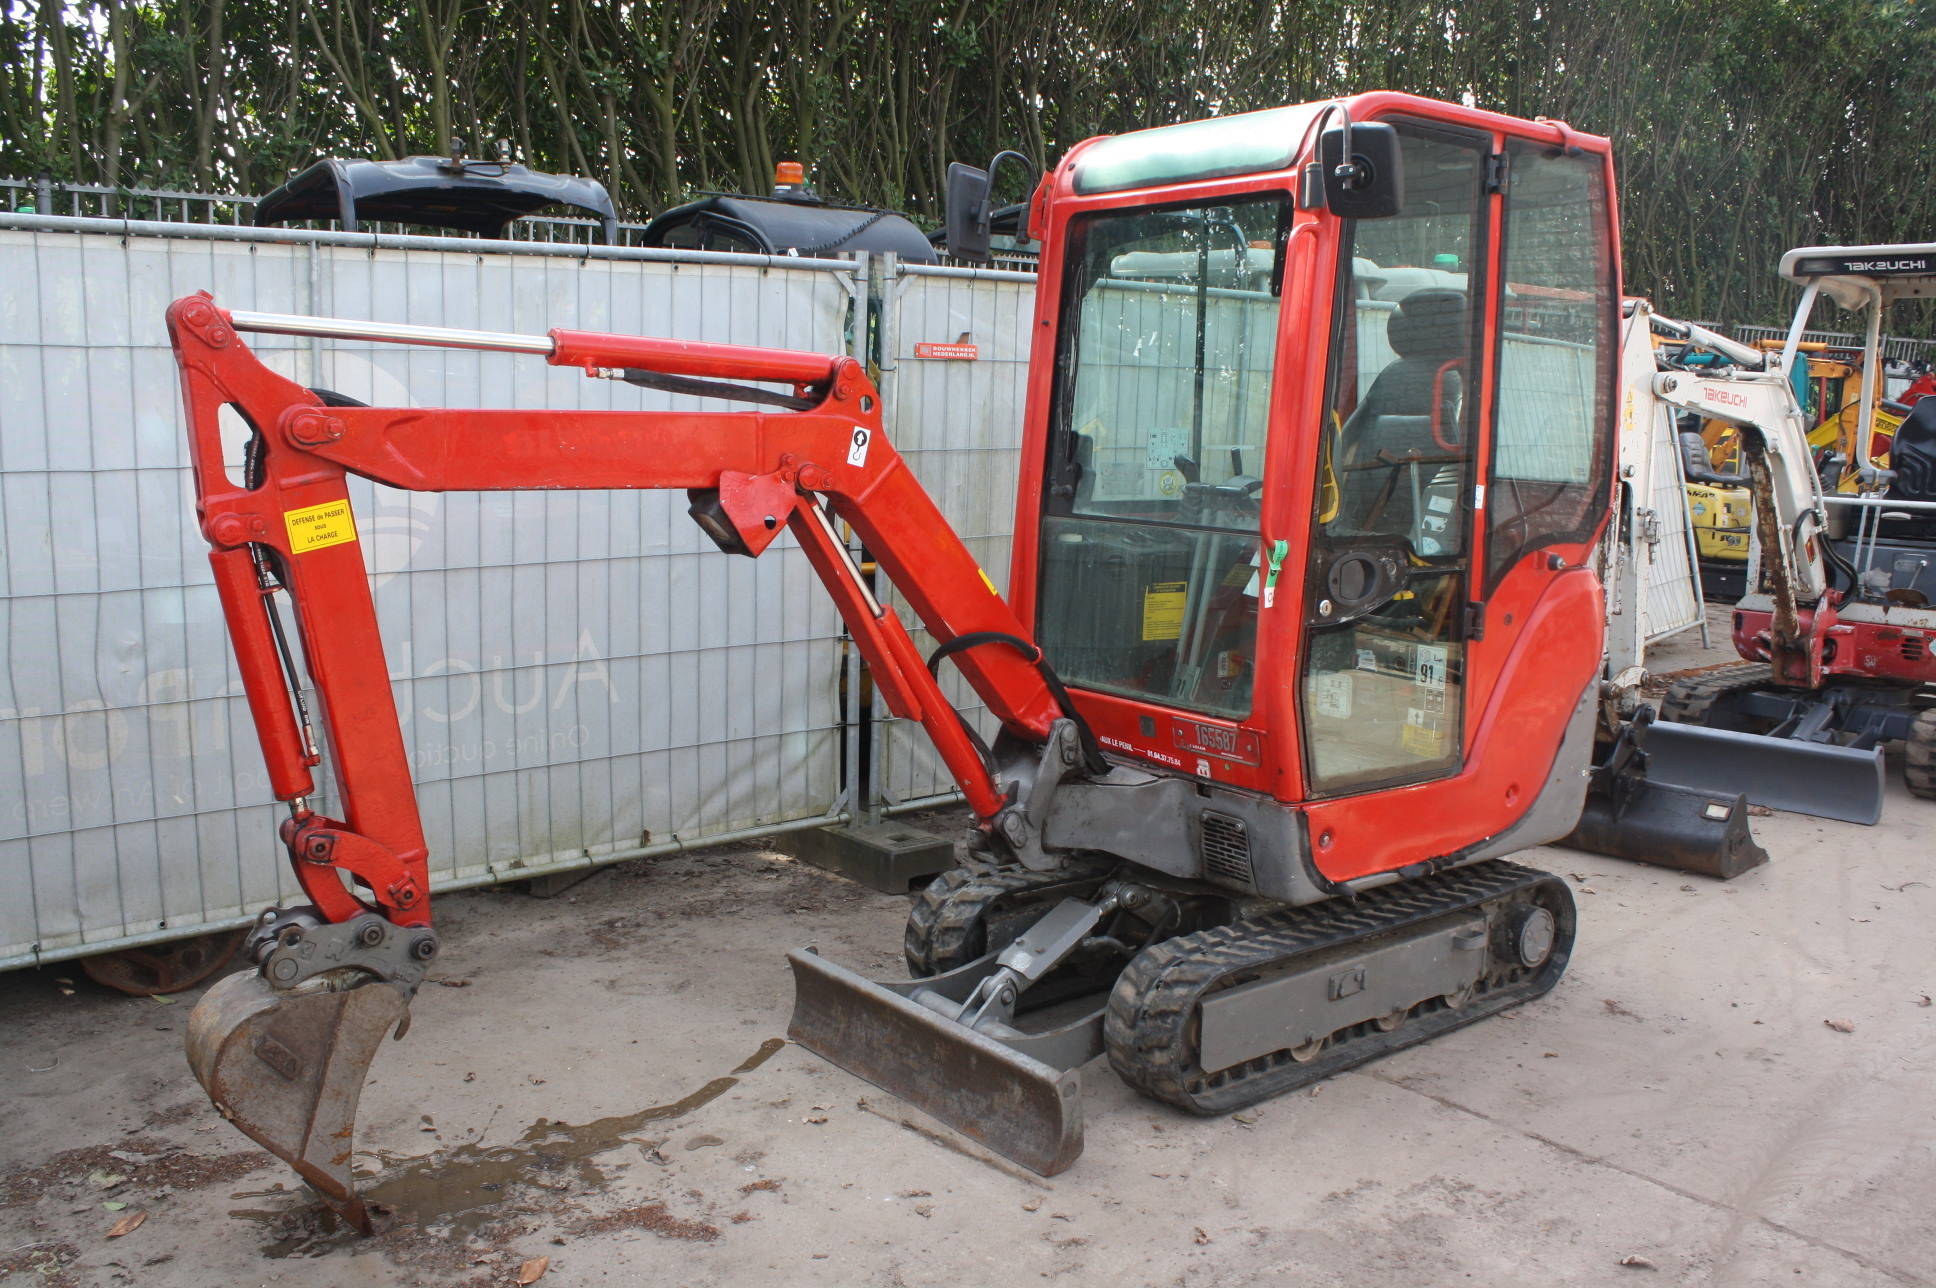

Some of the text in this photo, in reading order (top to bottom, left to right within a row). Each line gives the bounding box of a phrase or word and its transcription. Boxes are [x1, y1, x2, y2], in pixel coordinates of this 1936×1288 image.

[291, 514, 316, 527] DEFENSE
[324, 508, 345, 519] PASSER
[307, 530, 339, 544] LA CHARGE
[1421, 663, 1434, 685] 91
[1195, 724, 1237, 753] 165587
